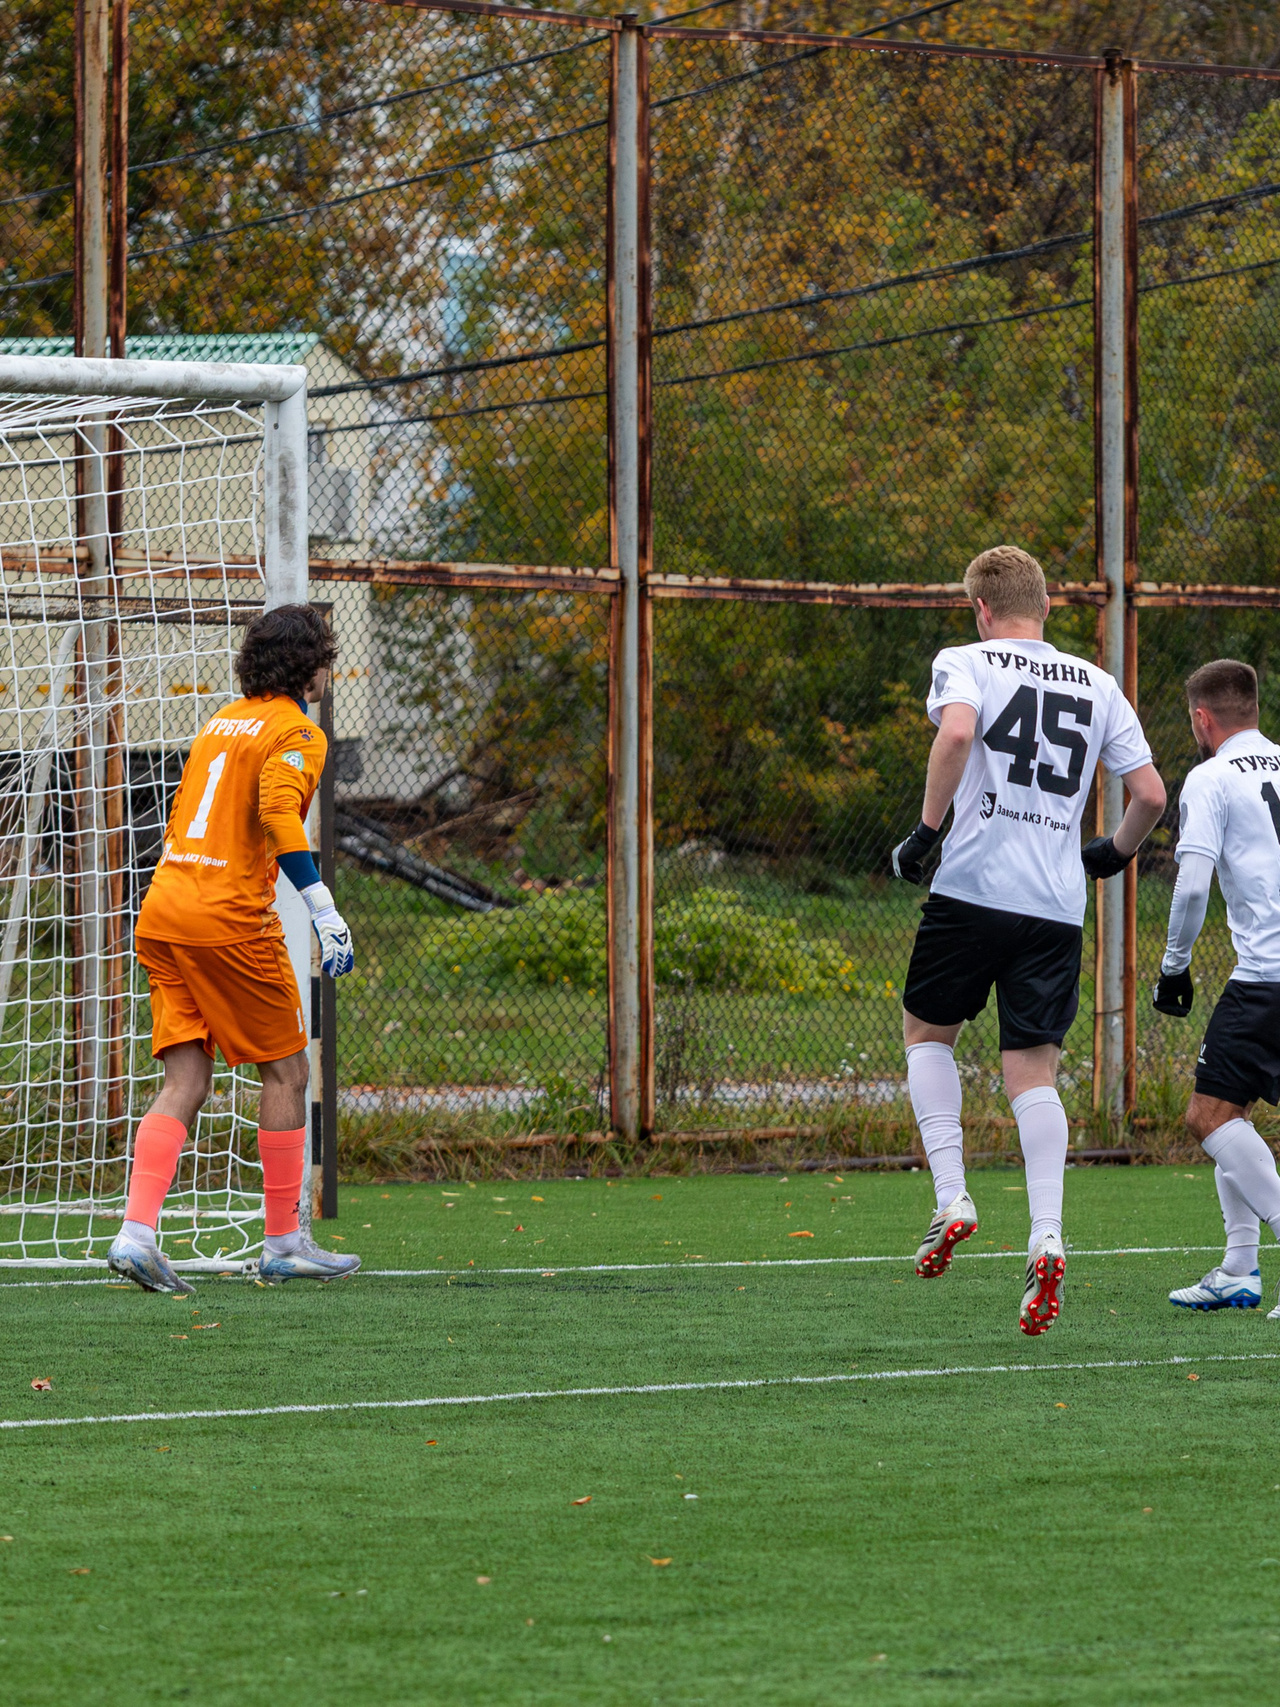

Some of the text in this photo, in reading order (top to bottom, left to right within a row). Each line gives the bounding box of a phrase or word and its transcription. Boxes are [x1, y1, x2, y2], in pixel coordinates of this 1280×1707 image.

[981, 650, 1092, 687] ТУРБИНА
[982, 684, 1093, 798] 45
[186, 752, 227, 839] 1
[996, 804, 1020, 822] Завод
[1022, 811, 1042, 825] АКЗ
[296, 1008, 303, 1033] 1
